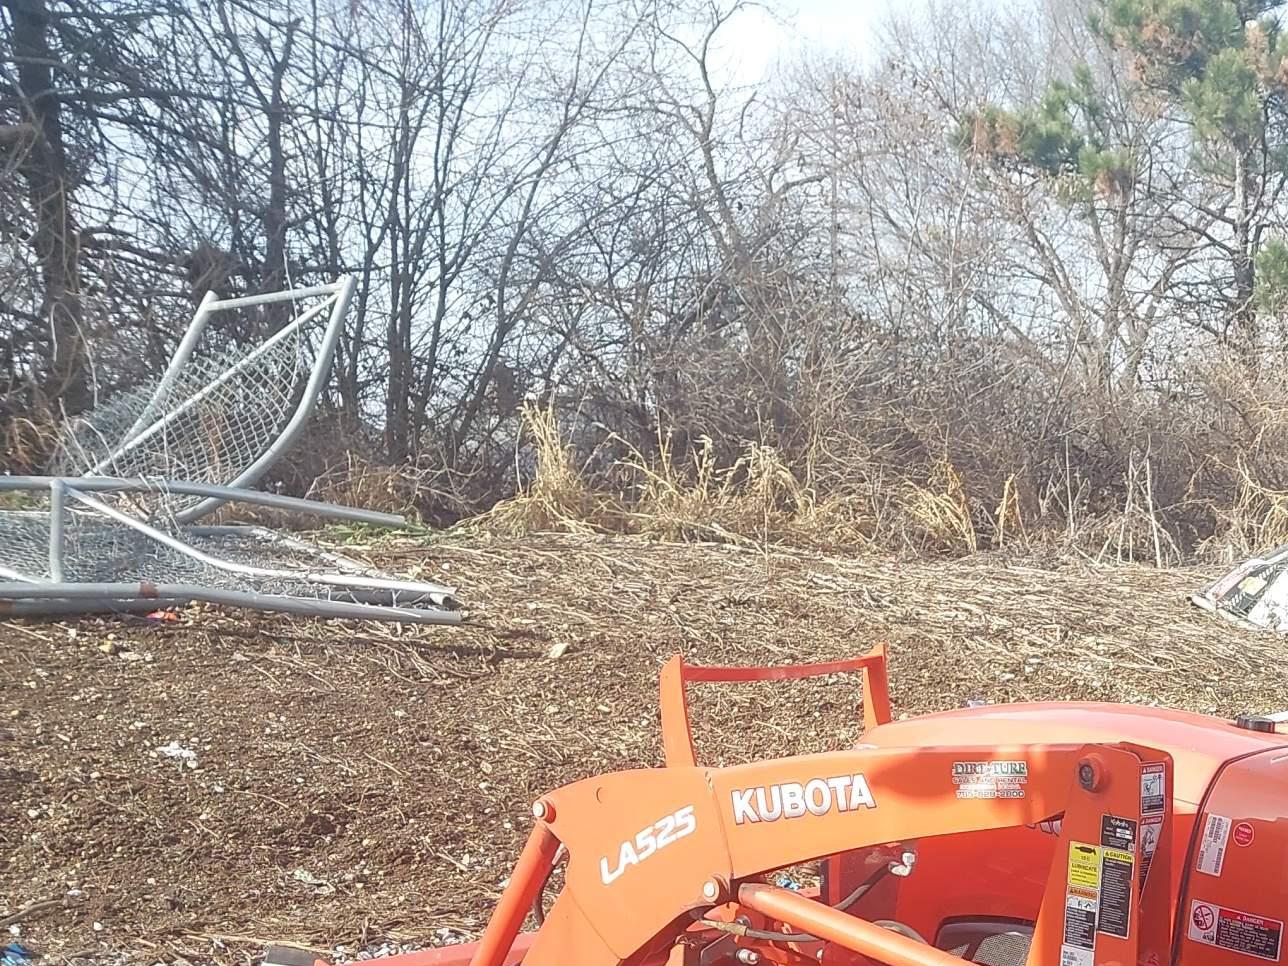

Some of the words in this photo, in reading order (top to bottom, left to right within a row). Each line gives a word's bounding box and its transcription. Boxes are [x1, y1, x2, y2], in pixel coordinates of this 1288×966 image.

[731, 773, 877, 825] KUBOTA
[599, 805, 697, 885] LA525
[1110, 852, 1132, 861] CAUTION
